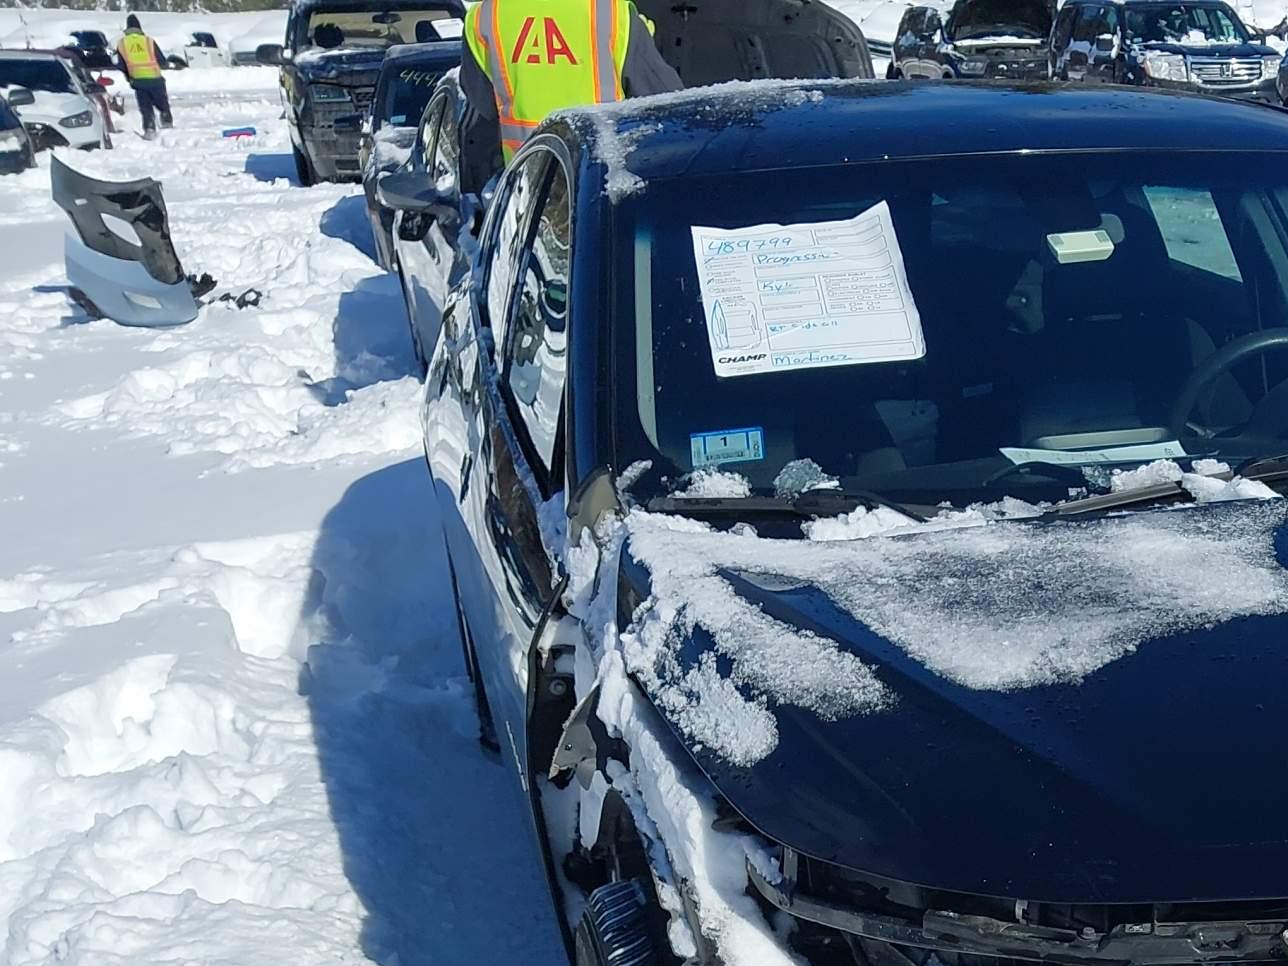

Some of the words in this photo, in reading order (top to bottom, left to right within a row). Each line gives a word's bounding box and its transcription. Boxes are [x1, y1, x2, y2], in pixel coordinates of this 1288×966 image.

[708, 237, 792, 255] 489799
[718, 353, 768, 364] CHAMP
[774, 351, 852, 366] Martinez
[720, 436, 728, 447] 1
